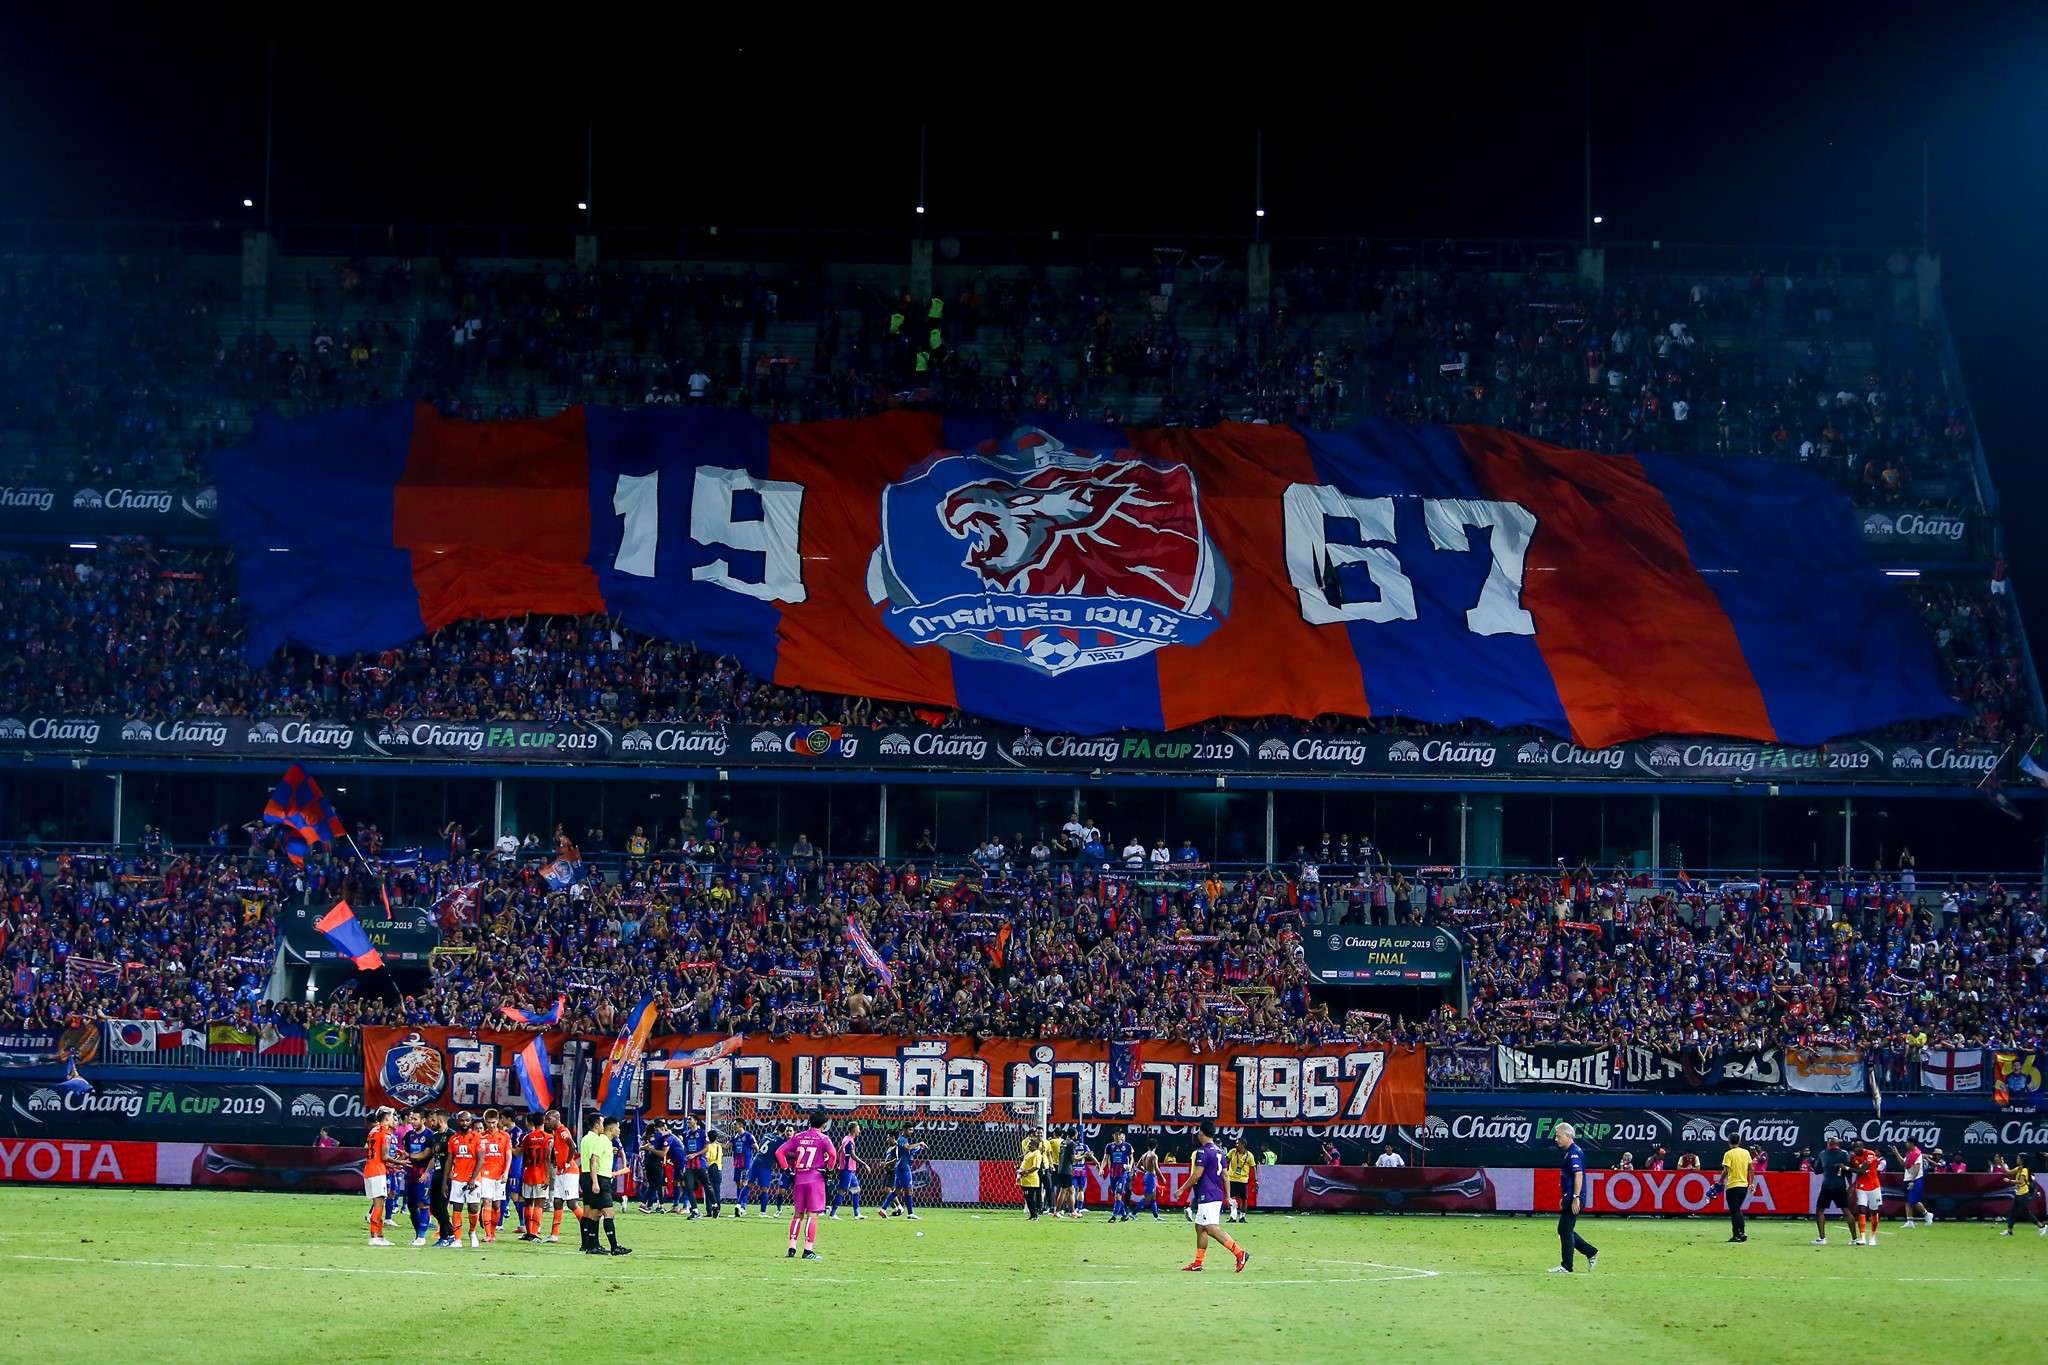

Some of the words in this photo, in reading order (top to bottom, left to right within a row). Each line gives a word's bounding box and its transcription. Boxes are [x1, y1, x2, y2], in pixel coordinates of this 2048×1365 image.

[105, 488, 172, 513] Chang
[1896, 514, 1965, 540] Chang
[613, 465, 806, 603] 19
[1283, 483, 1537, 636] 67
[1088, 651, 1125, 662] 1967
[28, 718, 100, 744] Chang
[155, 720, 227, 746] Chang
[281, 722, 353, 748] Chang
[411, 724, 484, 750] Chang
[487, 727, 516, 747] FA
[519, 731, 556, 748] CUP
[557, 734, 597, 749] 2019
[655, 729, 728, 755] Chang
[914, 733, 987, 760] Chang
[1046, 735, 1119, 761] Chang
[1122, 738, 1151, 758] FA
[1154, 743, 1192, 758] CUP
[1193, 744, 1234, 759] 2019
[1292, 738, 1366, 765] Chang
[1423, 741, 1496, 767] Chang
[1551, 743, 1625, 769] Chang
[1683, 746, 1756, 771] Chang
[1758, 748, 1788, 768] FA
[1828, 753, 1869, 769] 2019
[1926, 748, 1998, 773] Chang
[1345, 937, 1377, 949] Chang
[1379, 938, 1392, 948] FA
[1394, 940, 1410, 948] CUP
[1412, 940, 1430, 948] 2019
[1368, 952, 1407, 964] FINAL
[1498, 1045, 1613, 1089] HELLGATE
[396, 1083, 419, 1092] PORT
[1233, 1051, 1385, 1119] 1967
[64, 1089, 143, 1117] Chang
[146, 1091, 176, 1114] FA
[181, 1097, 220, 1114] CUP
[222, 1098, 265, 1114] 2019
[1452, 1115, 1532, 1143] Chang
[1613, 1124, 1657, 1140] 2019
[1719, 1118, 1799, 1147] Chang
[1862, 1119, 1941, 1148] Chang
[796, 1146, 817, 1169] 27
